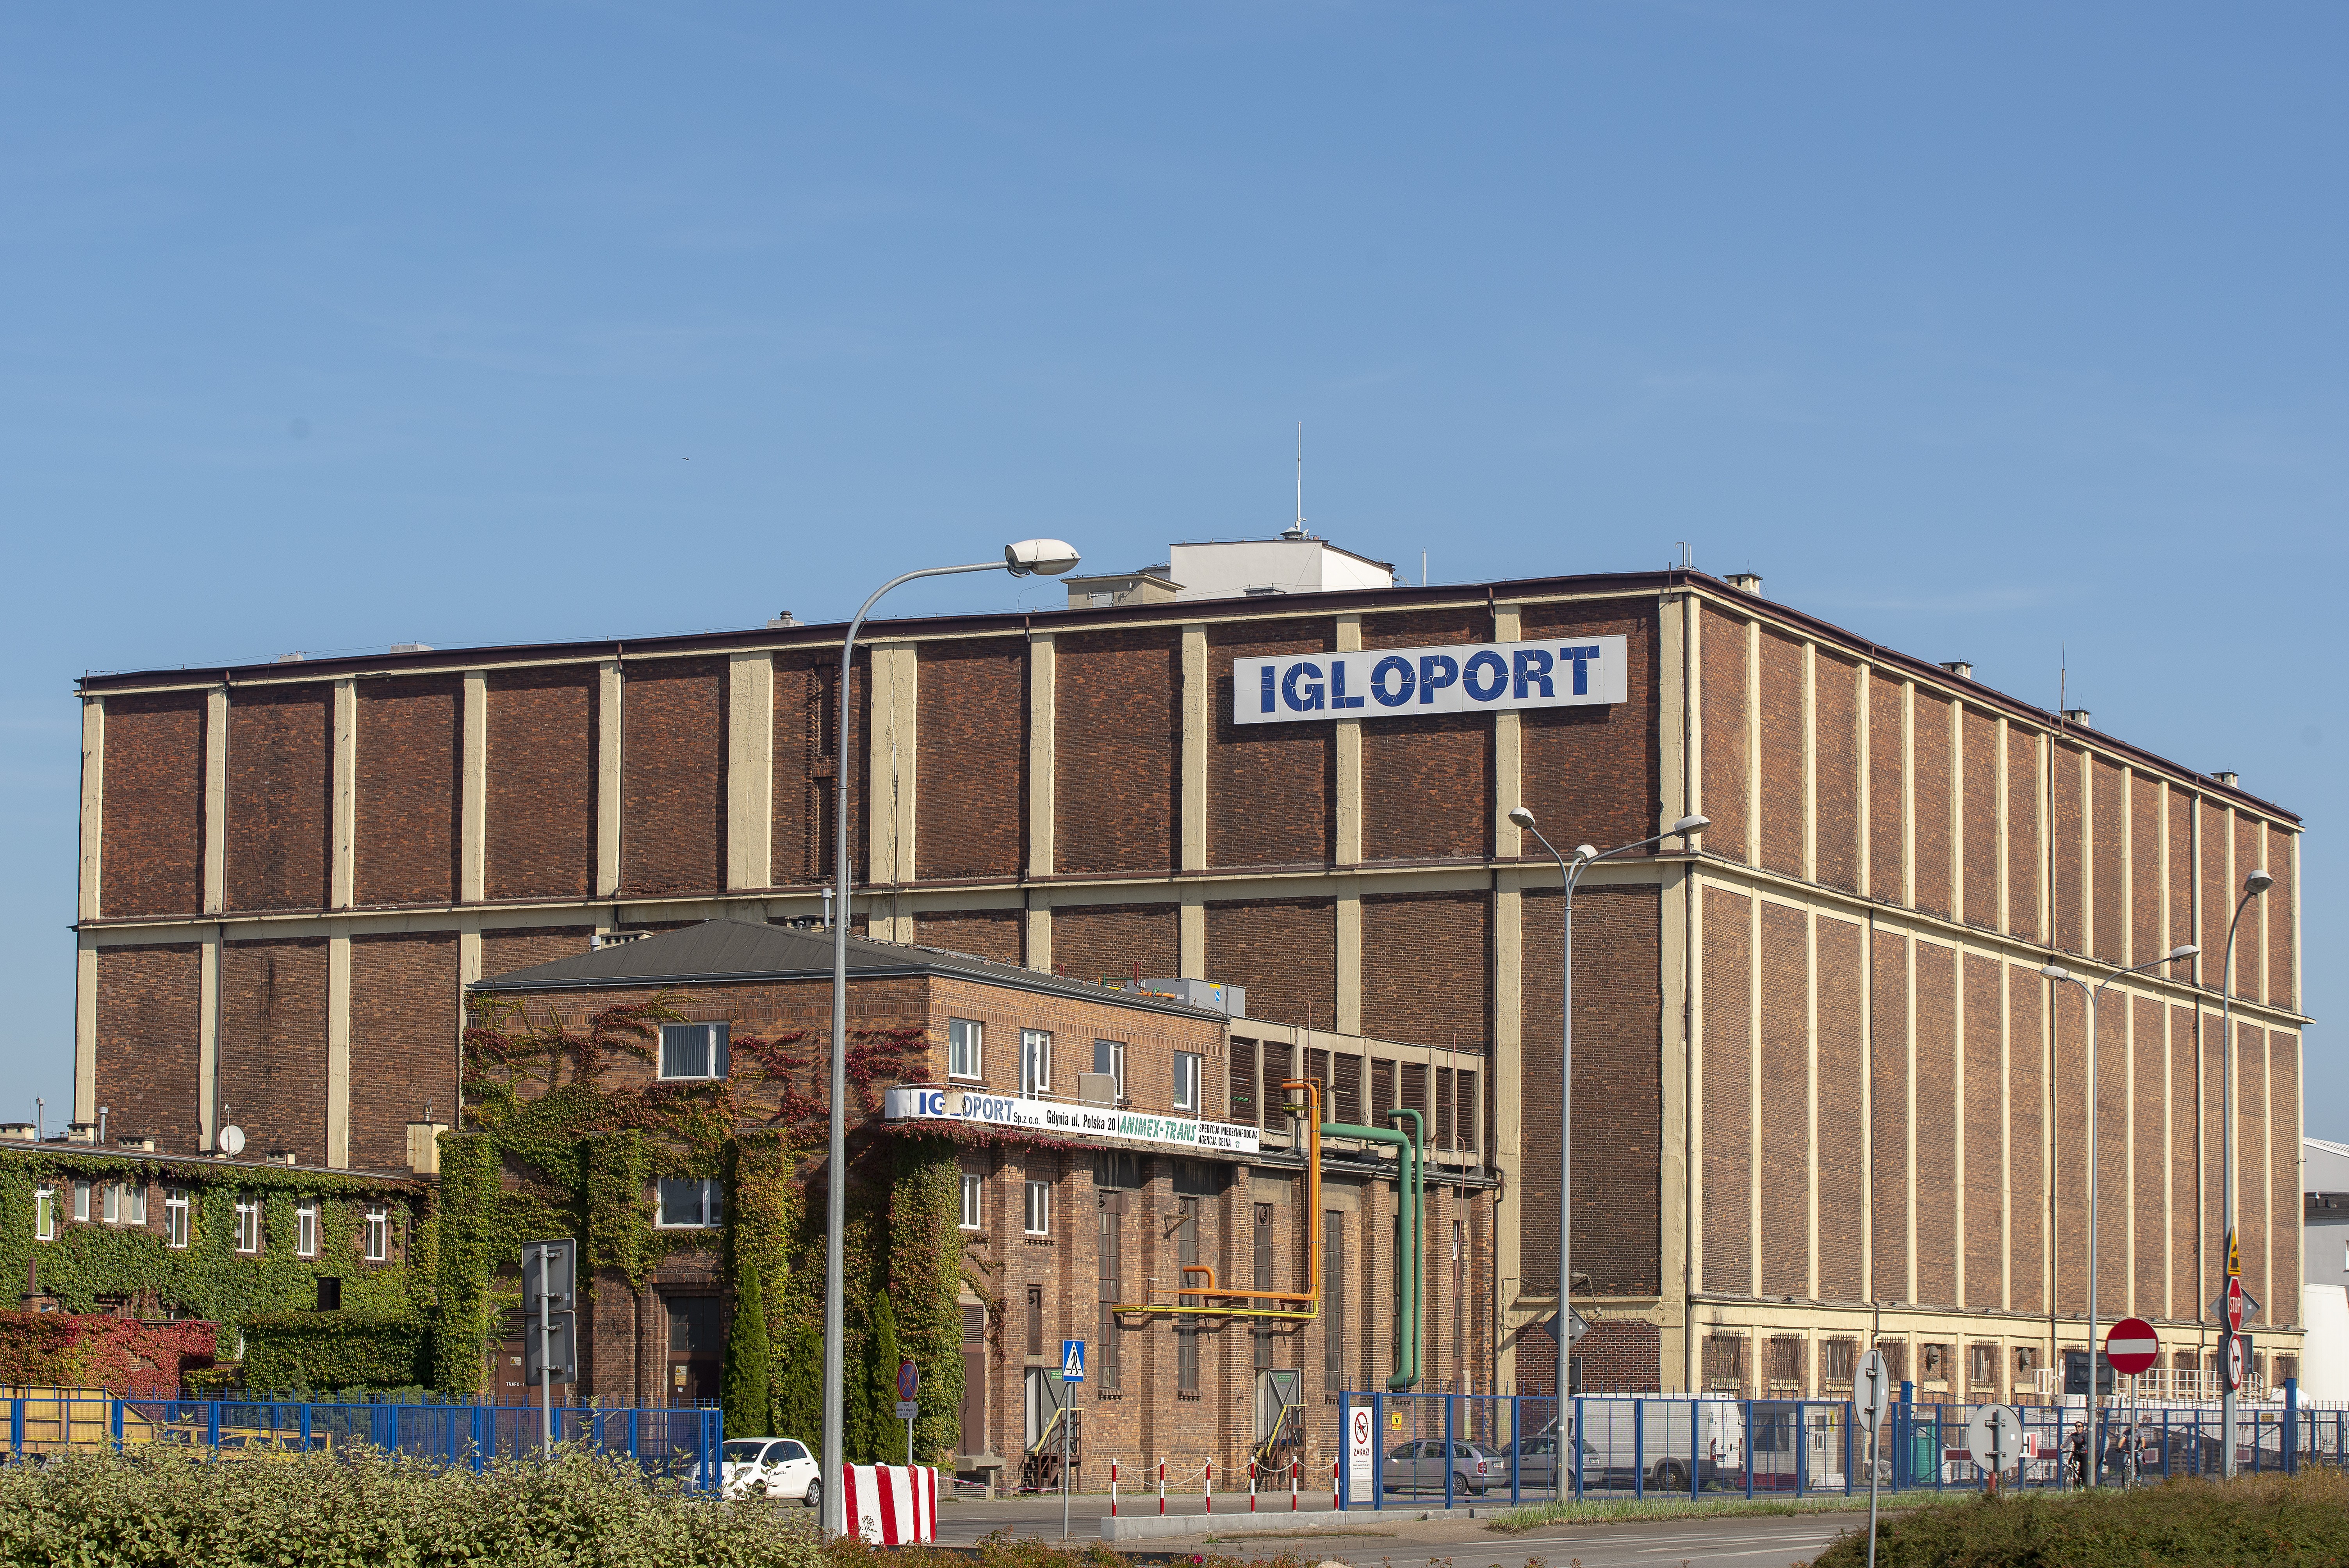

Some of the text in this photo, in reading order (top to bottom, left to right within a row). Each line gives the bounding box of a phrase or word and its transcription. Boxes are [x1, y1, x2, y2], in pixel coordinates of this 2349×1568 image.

[1261, 645, 1599, 713] IGLOPORT
[919, 1092, 1014, 1122] IGOPORT
[1028, 1117, 1040, 1125] o.o.
[1047, 1110, 1069, 1128] Gdynia
[1083, 1114, 1105, 1130] Polska
[1108, 1117, 1116, 1131] 20
[1120, 1115, 1197, 1142] ANIMEX-TRANS
[1199, 1123, 1258, 1139] SPEDYCJA MIĘDZYNARODOWA
[1198, 1135, 1231, 1147] AGENCJA CELNA
[2230, 1296, 2241, 1313] STOP
[1353, 1448, 1369, 1456] ZAKAZ!
